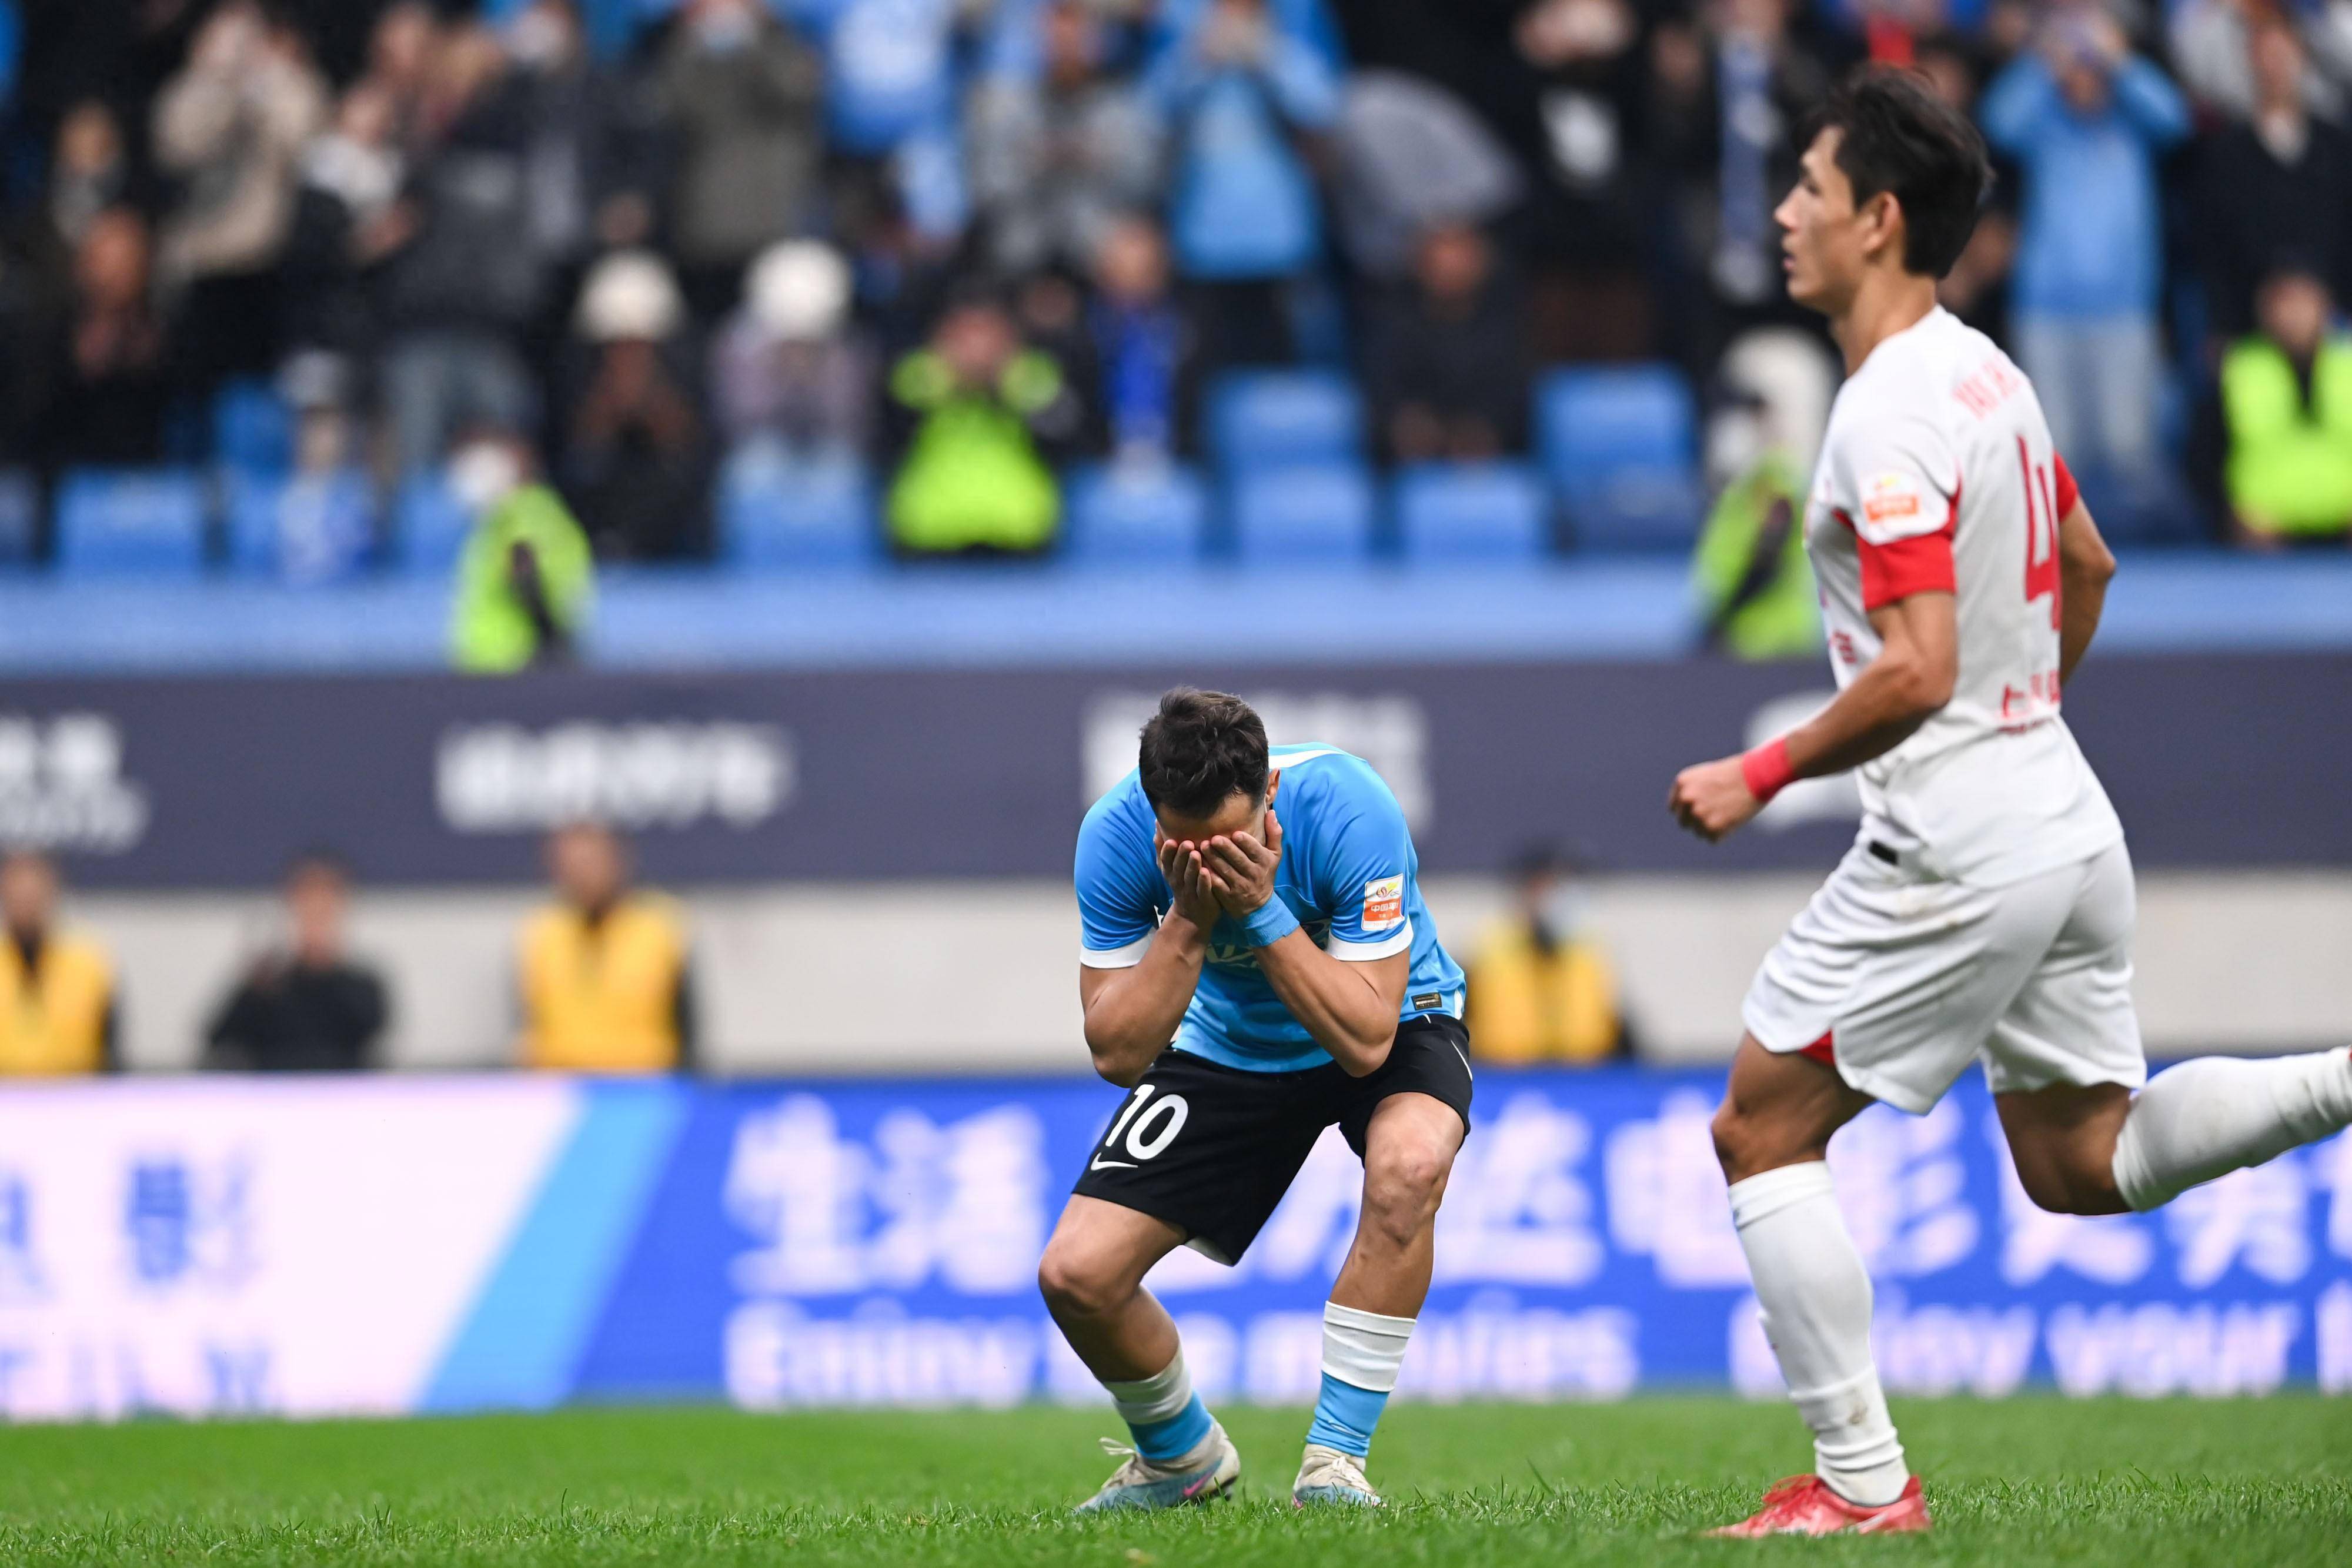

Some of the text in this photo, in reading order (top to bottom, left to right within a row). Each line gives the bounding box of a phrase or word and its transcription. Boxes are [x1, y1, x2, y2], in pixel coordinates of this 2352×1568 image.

[2017, 434, 2063, 632] 4
[1371, 902, 1399, 912] 中国平
[1105, 1083, 1189, 1161] 10
